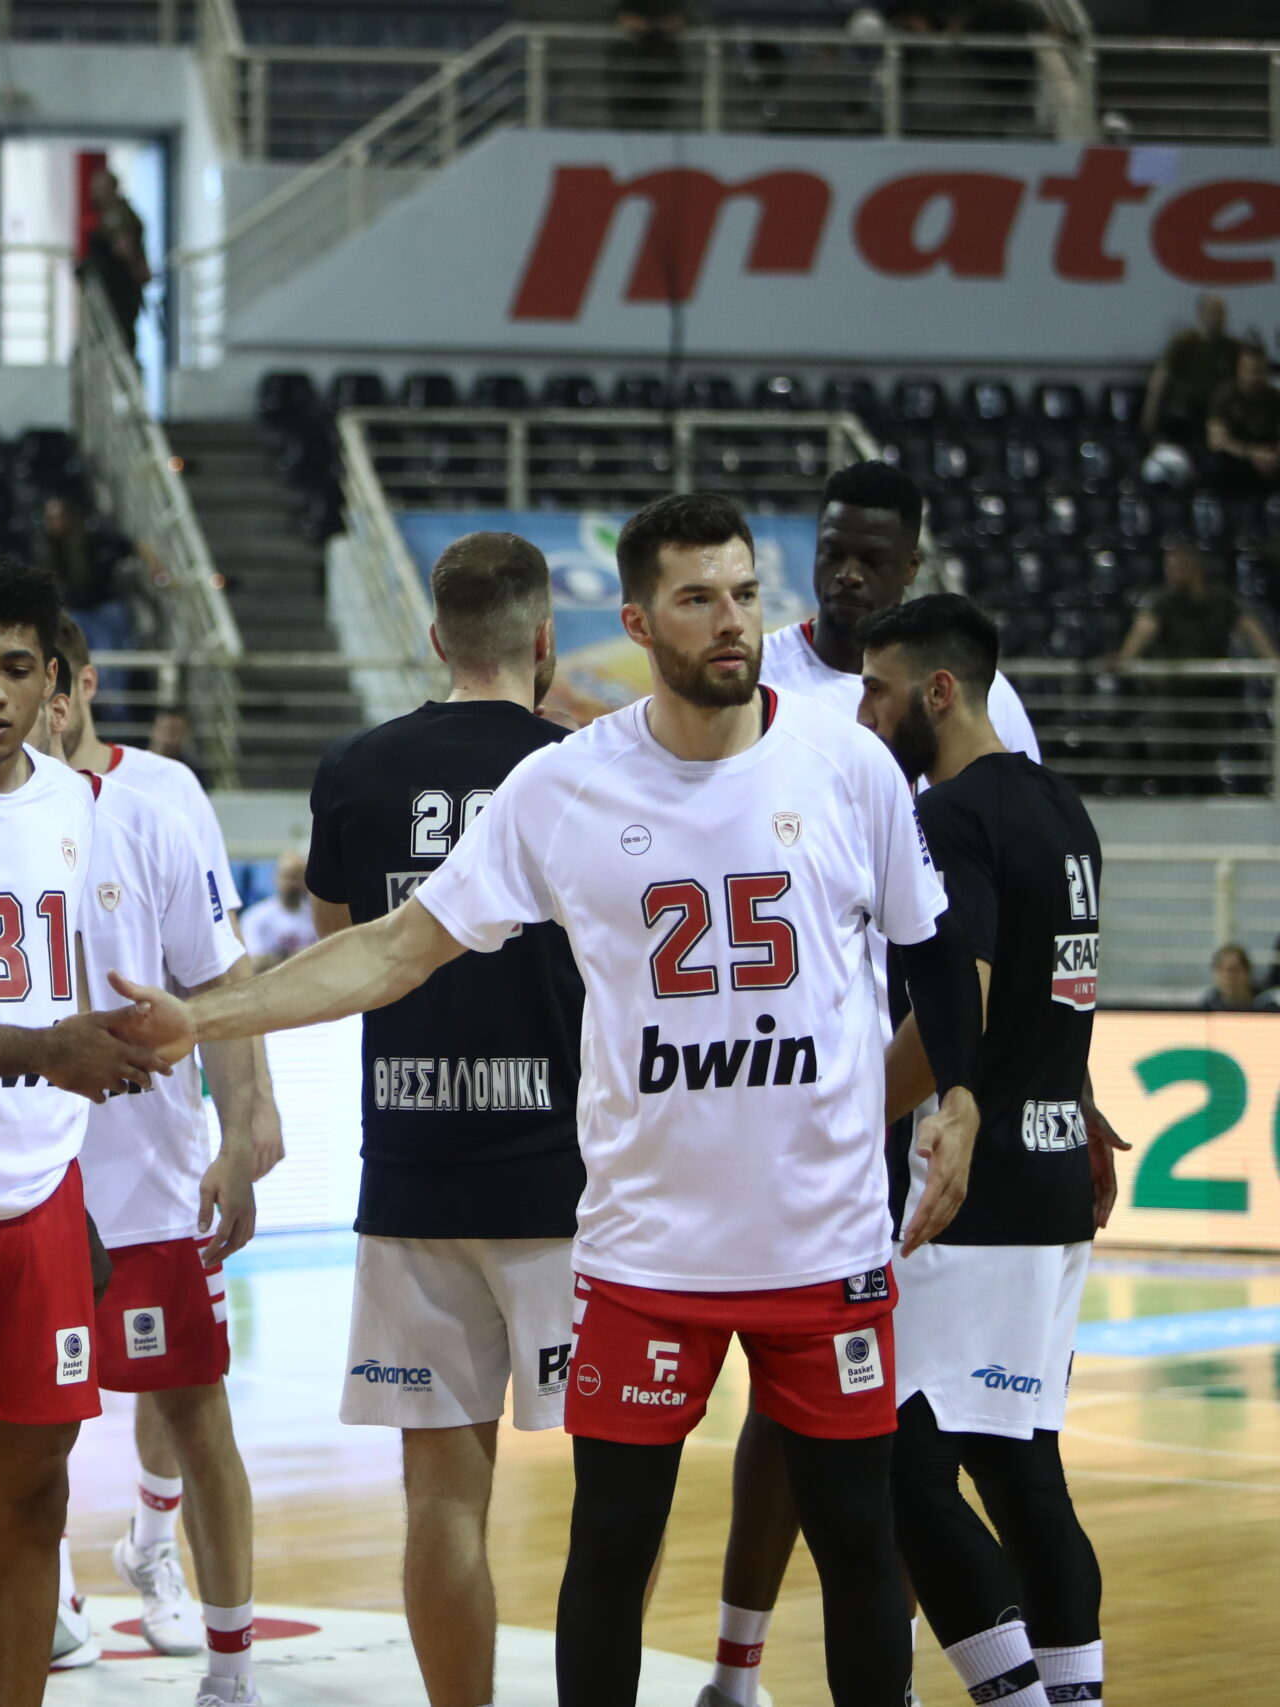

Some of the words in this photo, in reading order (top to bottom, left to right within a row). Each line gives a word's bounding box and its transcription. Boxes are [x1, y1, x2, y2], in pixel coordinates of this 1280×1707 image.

[1065, 855, 1098, 920] 21
[641, 871, 799, 999] 25
[639, 1014, 817, 1094] bwin
[1131, 1045, 1280, 1215] 2
[134, 1337, 158, 1345] Basket
[134, 1344, 159, 1352] League
[62, 1368, 82, 1378] League
[63, 1360, 83, 1370] Basket
[847, 1364, 874, 1377] Basket
[365, 1366, 433, 1386] avance
[849, 1373, 875, 1385] League
[984, 1372, 1042, 1395] avan
[621, 1385, 687, 1405] FlexCar
